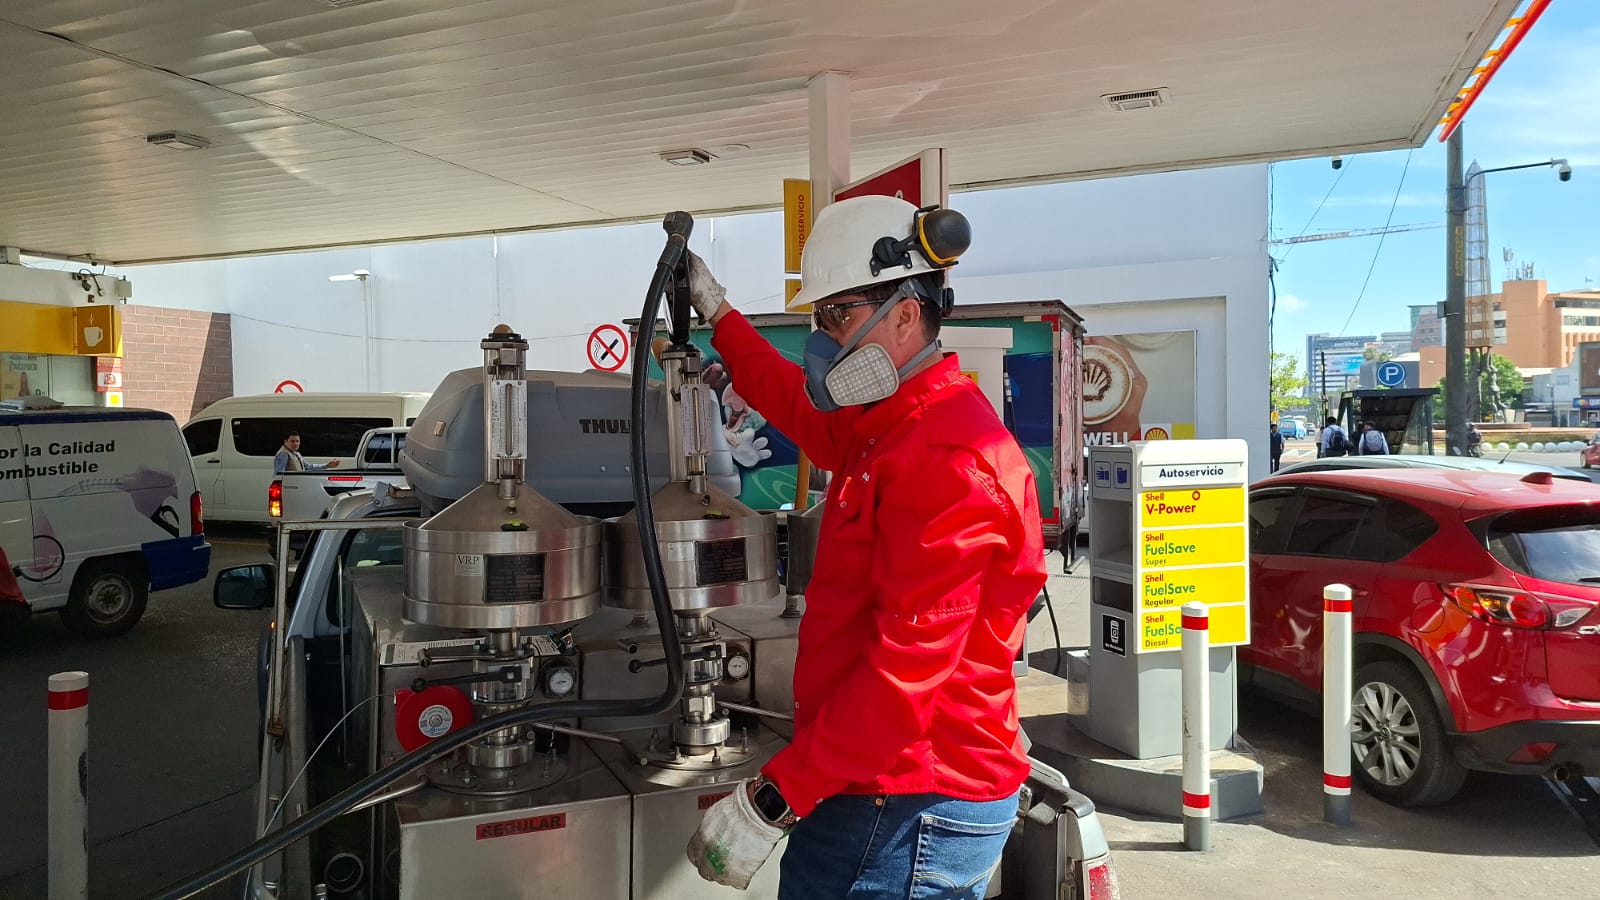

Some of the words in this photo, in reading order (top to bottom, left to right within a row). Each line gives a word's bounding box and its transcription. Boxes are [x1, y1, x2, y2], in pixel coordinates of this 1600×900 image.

[1386, 367, 1399, 381] P
[579, 419, 631, 433] THUL
[1083, 432, 1130, 446] WELL
[24, 443, 42, 457] la
[48, 440, 115, 456] Calidad
[1159, 465, 1224, 478] Autoservicio
[1145, 493, 1164, 501] Shell
[1146, 503, 1196, 515] V-Power
[1145, 533, 1164, 542] Shell
[1145, 542, 1196, 556] FuelSave
[458, 556, 479, 565] VRP
[1145, 558, 1167, 567] Super
[1145, 574, 1164, 583] Shell
[1145, 583, 1196, 596] FuelSave
[1145, 598, 1174, 607] Regular
[1145, 615, 1164, 624] Shell
[1145, 624, 1182, 637] FuelSa
[1145, 638, 1168, 647] Diesel
[483, 816, 561, 836] REGULAR
